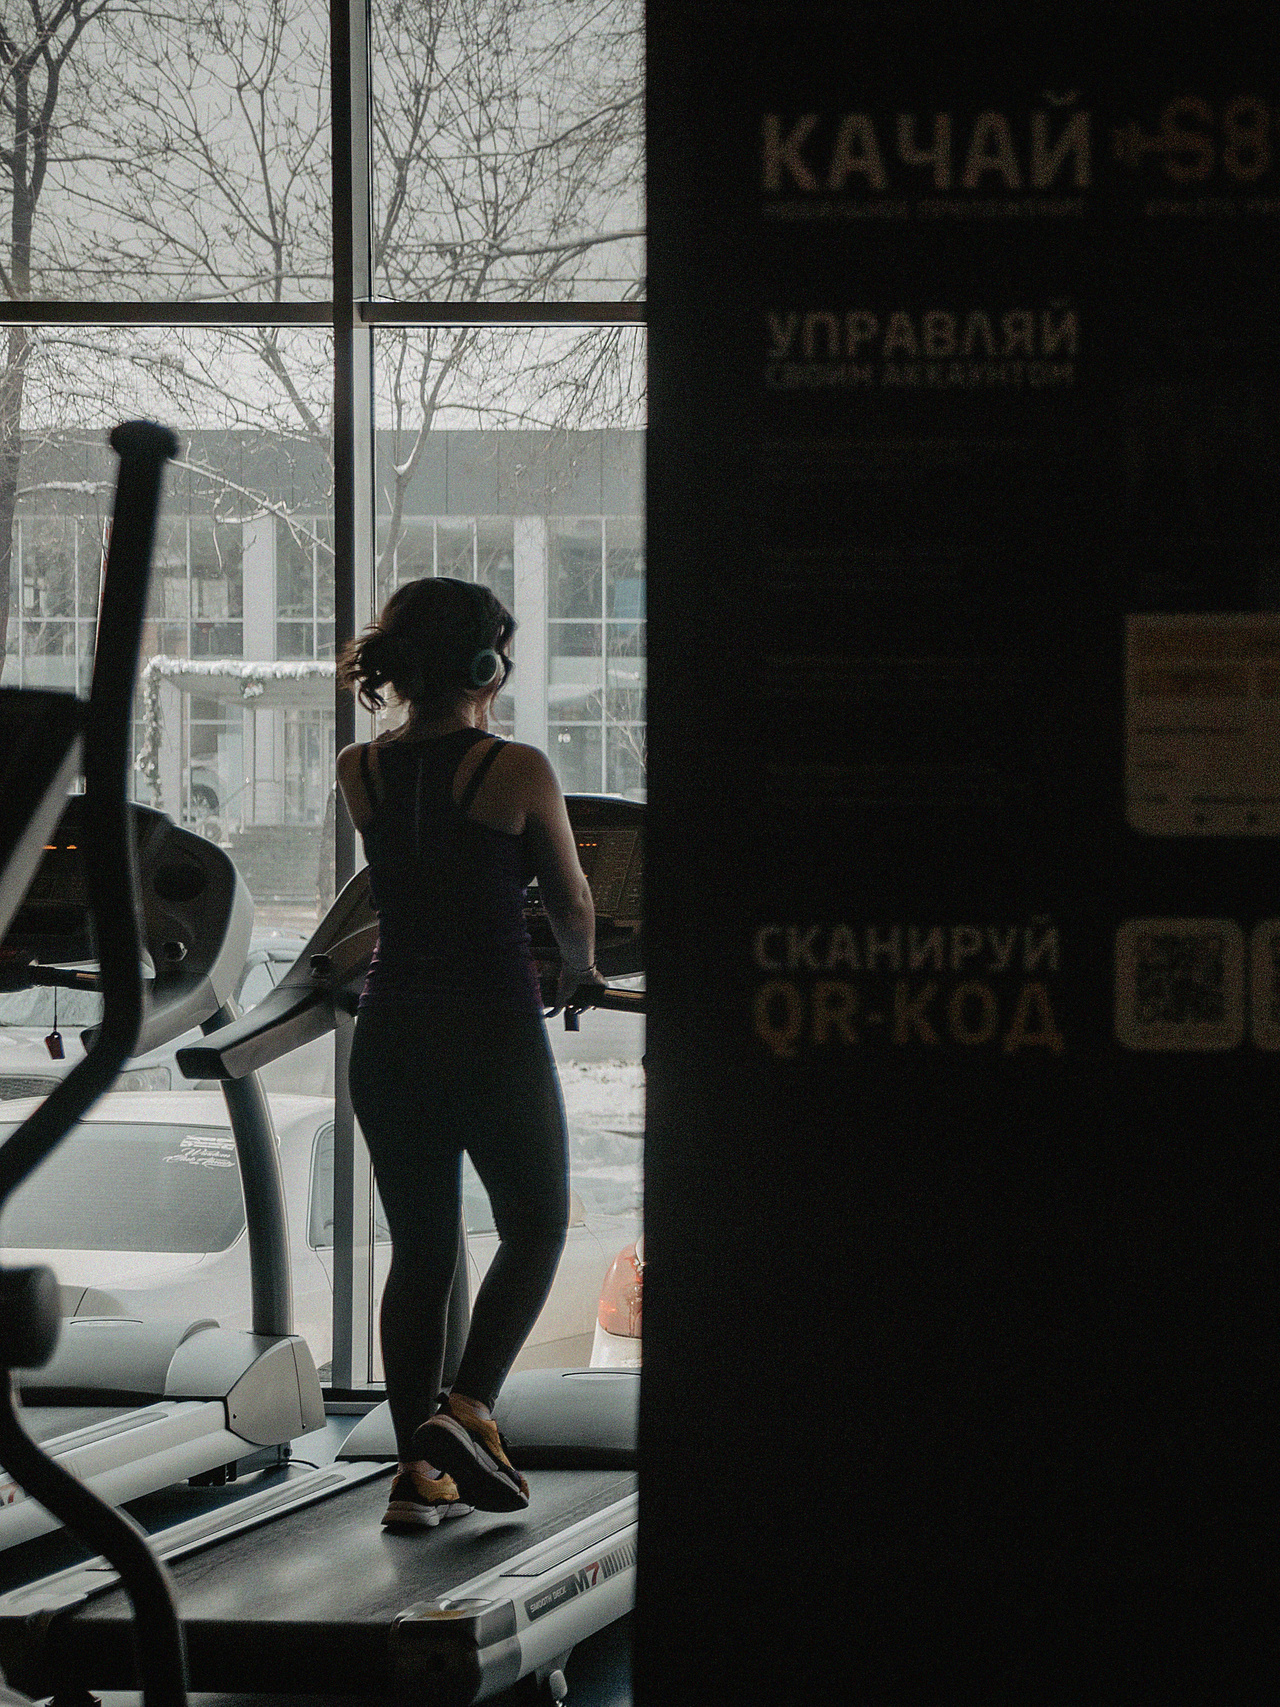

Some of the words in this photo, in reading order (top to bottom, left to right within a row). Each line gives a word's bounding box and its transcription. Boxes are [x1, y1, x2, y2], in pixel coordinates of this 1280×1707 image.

[761, 88, 1092, 191] КАЧАЙ
[766, 297, 1079, 358] УПРАВЛЯЙ
[754, 913, 1061, 971] СКАНИРУЙ
[753, 979, 1066, 1057] QR-КОД
